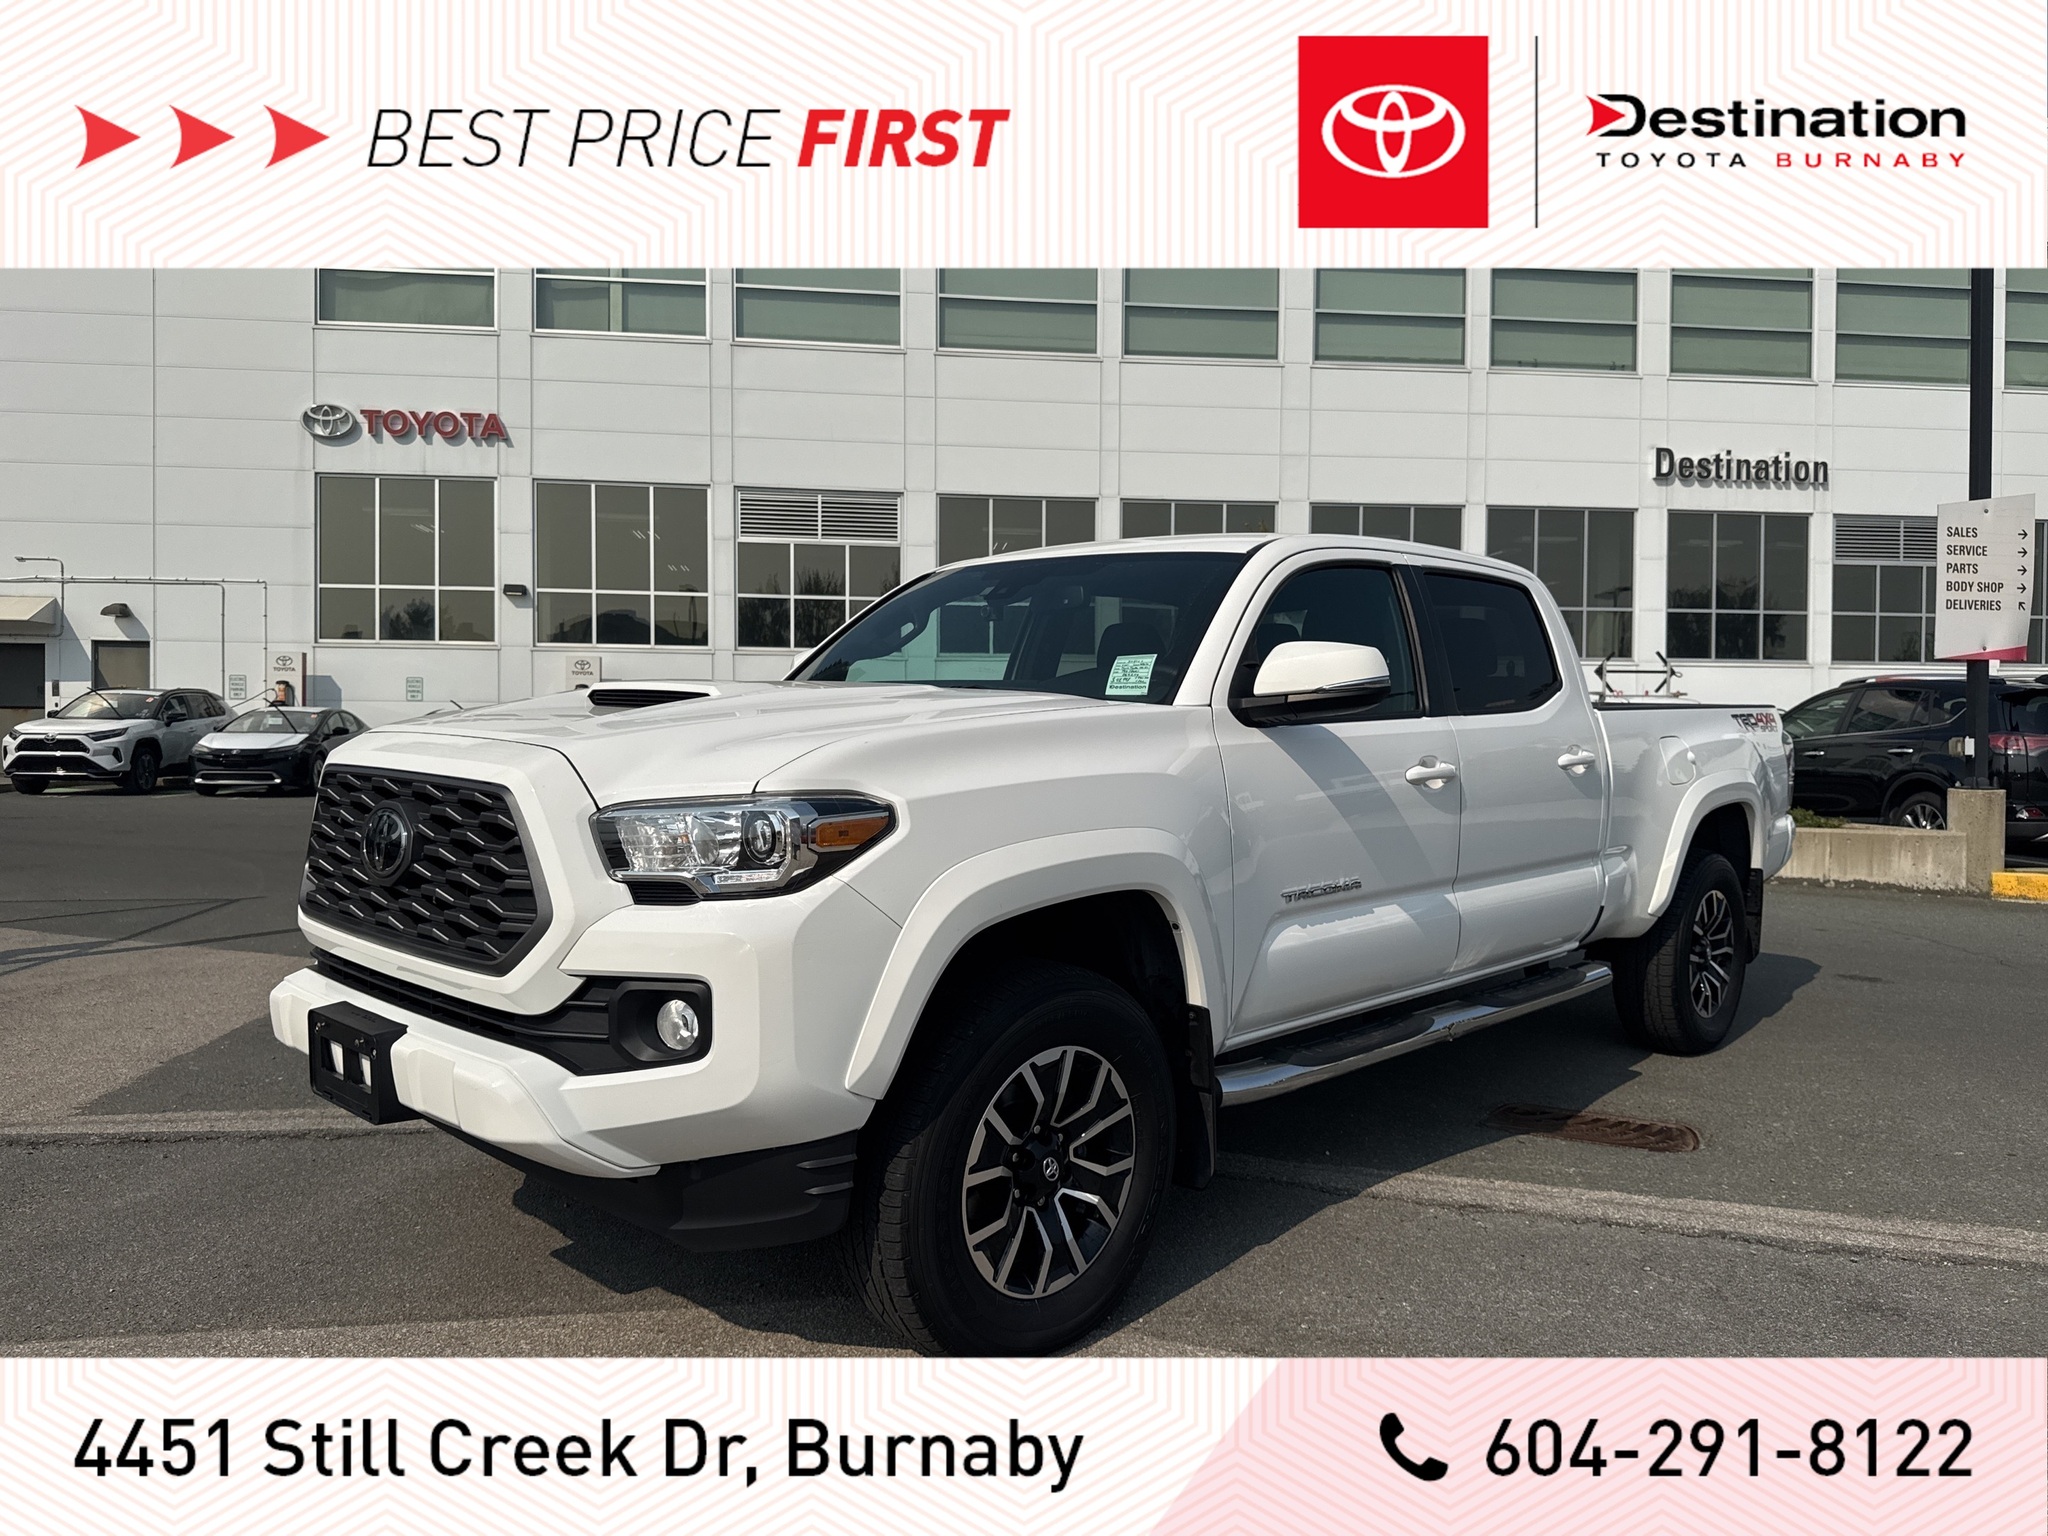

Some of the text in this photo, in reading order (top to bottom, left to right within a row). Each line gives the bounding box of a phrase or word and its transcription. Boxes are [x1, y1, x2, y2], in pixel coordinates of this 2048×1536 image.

[360, 409, 506, 439] TOYOTA
[1653, 447, 1829, 485] Destination
[1946, 526, 1978, 538] SALES
[1946, 544, 1988, 557] SERVICE
[1946, 562, 1979, 575] PARTS
[1946, 580, 2004, 593] BODY SHOP
[1945, 598, 2002, 611] DELIVERIES
[1731, 713, 1758, 732] TRD
[1760, 725, 1778, 733] SPORT
